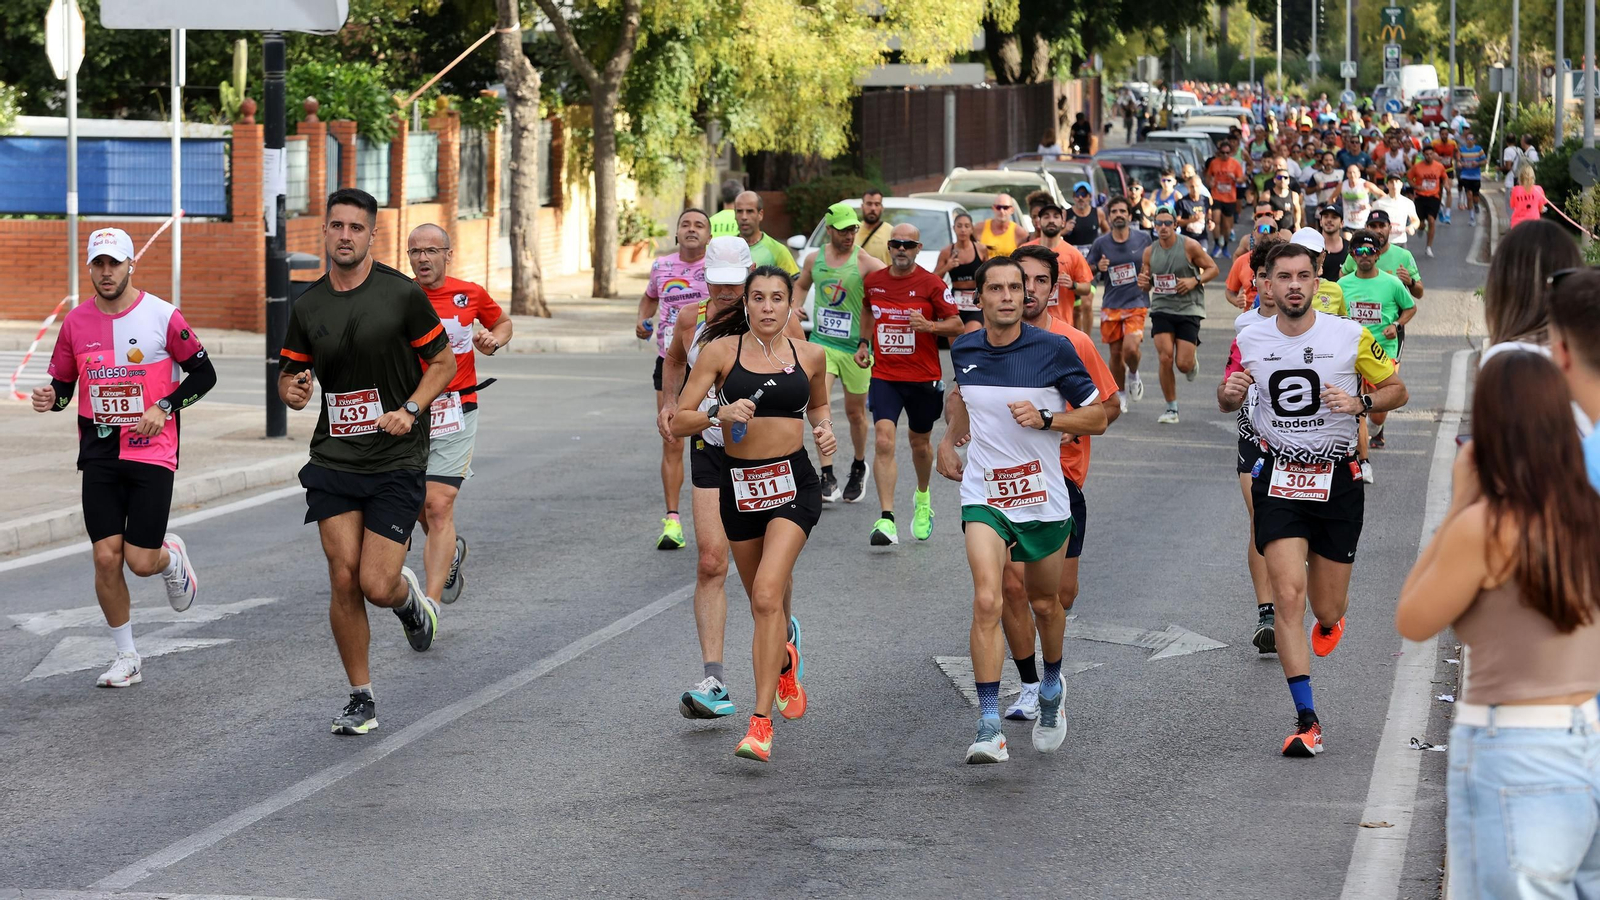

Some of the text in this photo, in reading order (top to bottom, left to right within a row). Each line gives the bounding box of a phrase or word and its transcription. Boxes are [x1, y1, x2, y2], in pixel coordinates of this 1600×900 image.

[1116, 271, 1129, 279] 307
[880, 307, 903, 315] muebles
[1357, 309, 1374, 319] 349
[823, 317, 842, 329] 599
[884, 334, 905, 345] 290
[86, 365, 128, 380] indeso
[101, 398, 130, 413] 518
[339, 405, 368, 422] 439
[431, 411, 446, 426] 77
[1271, 418, 1325, 429] asodena
[997, 478, 1031, 496] 512
[1286, 473, 1316, 488] 304
[747, 479, 779, 497] 511
[391, 524, 404, 535] FILA
